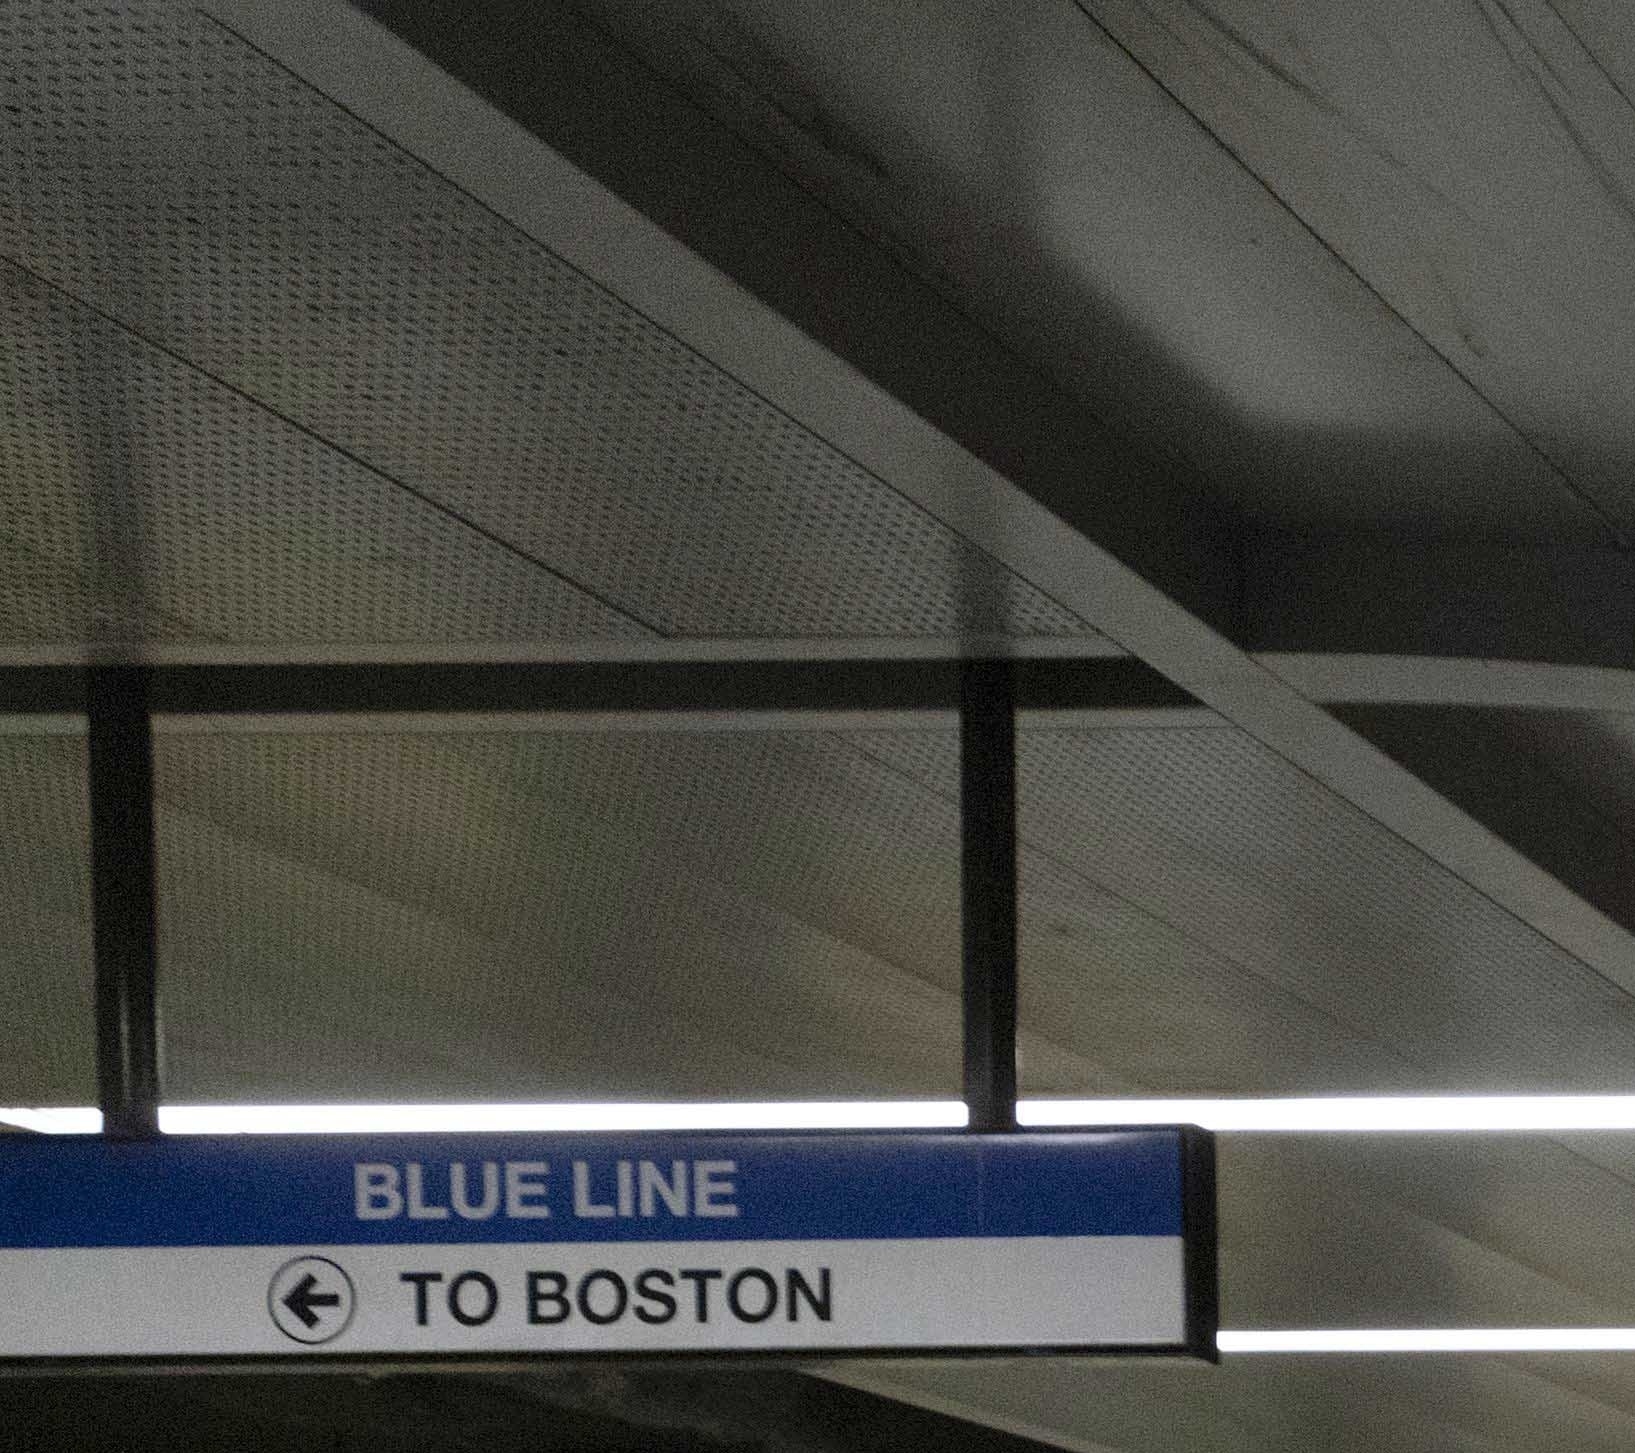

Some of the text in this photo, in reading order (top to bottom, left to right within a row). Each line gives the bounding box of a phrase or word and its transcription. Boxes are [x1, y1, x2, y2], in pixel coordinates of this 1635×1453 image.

[356, 1160, 737, 1219] BLUE LINE
[399, 1267, 832, 1327] TO BOSTON
